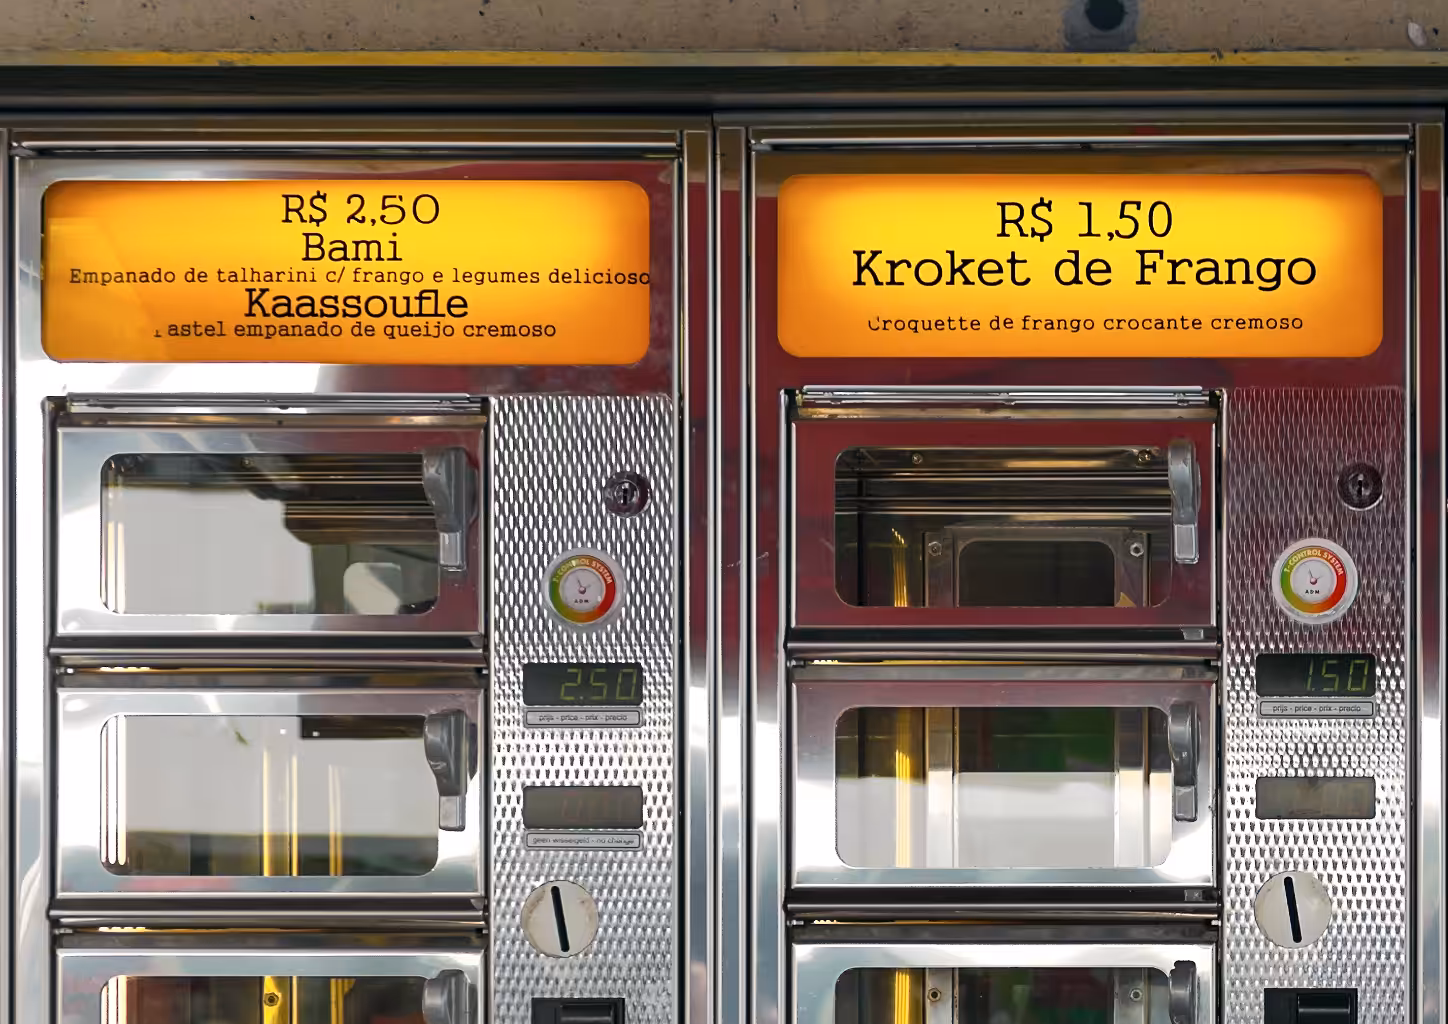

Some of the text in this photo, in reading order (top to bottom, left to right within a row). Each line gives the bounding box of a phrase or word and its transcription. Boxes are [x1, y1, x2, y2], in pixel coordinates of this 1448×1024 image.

[282, 190, 440, 227] R$ 2,50
[997, 197, 1173, 242] R$ 1,50
[302, 231, 403, 263] Bami
[69, 267, 650, 287] Empanado de talharini c/ frango e legumes delicioso
[853, 249, 1317, 292] Kroket de Frango
[244, 287, 469, 319] Kaassoufle
[153, 320, 557, 340] astel empanado de queijo cremoso
[989, 315, 1014, 331] de
[1021, 315, 1095, 333] frango
[1103, 315, 1203, 331] crocante
[1210, 318, 1303, 331] cremoso
[591, 560, 613, 584] SYSTEM
[1283, 549, 1322, 572] T-CONTROL
[1322, 552, 1344, 576] SYSTEM
[560, 668, 637, 700] 2.50
[1306, 660, 1369, 692] 1.50
[1294, 704, 1312, 712] price
